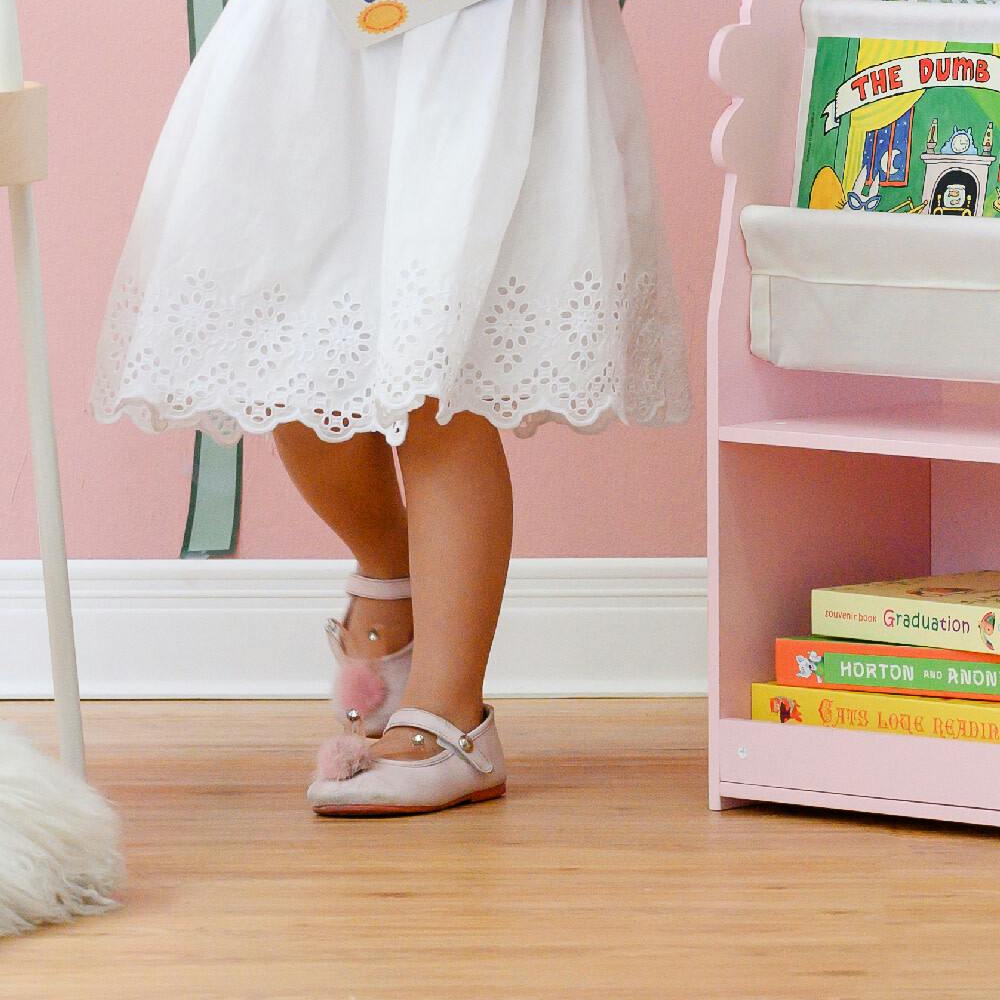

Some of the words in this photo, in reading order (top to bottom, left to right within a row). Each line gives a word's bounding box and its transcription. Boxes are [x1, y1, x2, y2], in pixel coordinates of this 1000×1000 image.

[851, 65, 903, 100] THE
[919, 58, 990, 84] DUMB
[883, 609, 970, 634] Graduation
[840, 662, 915, 681] HORTON
